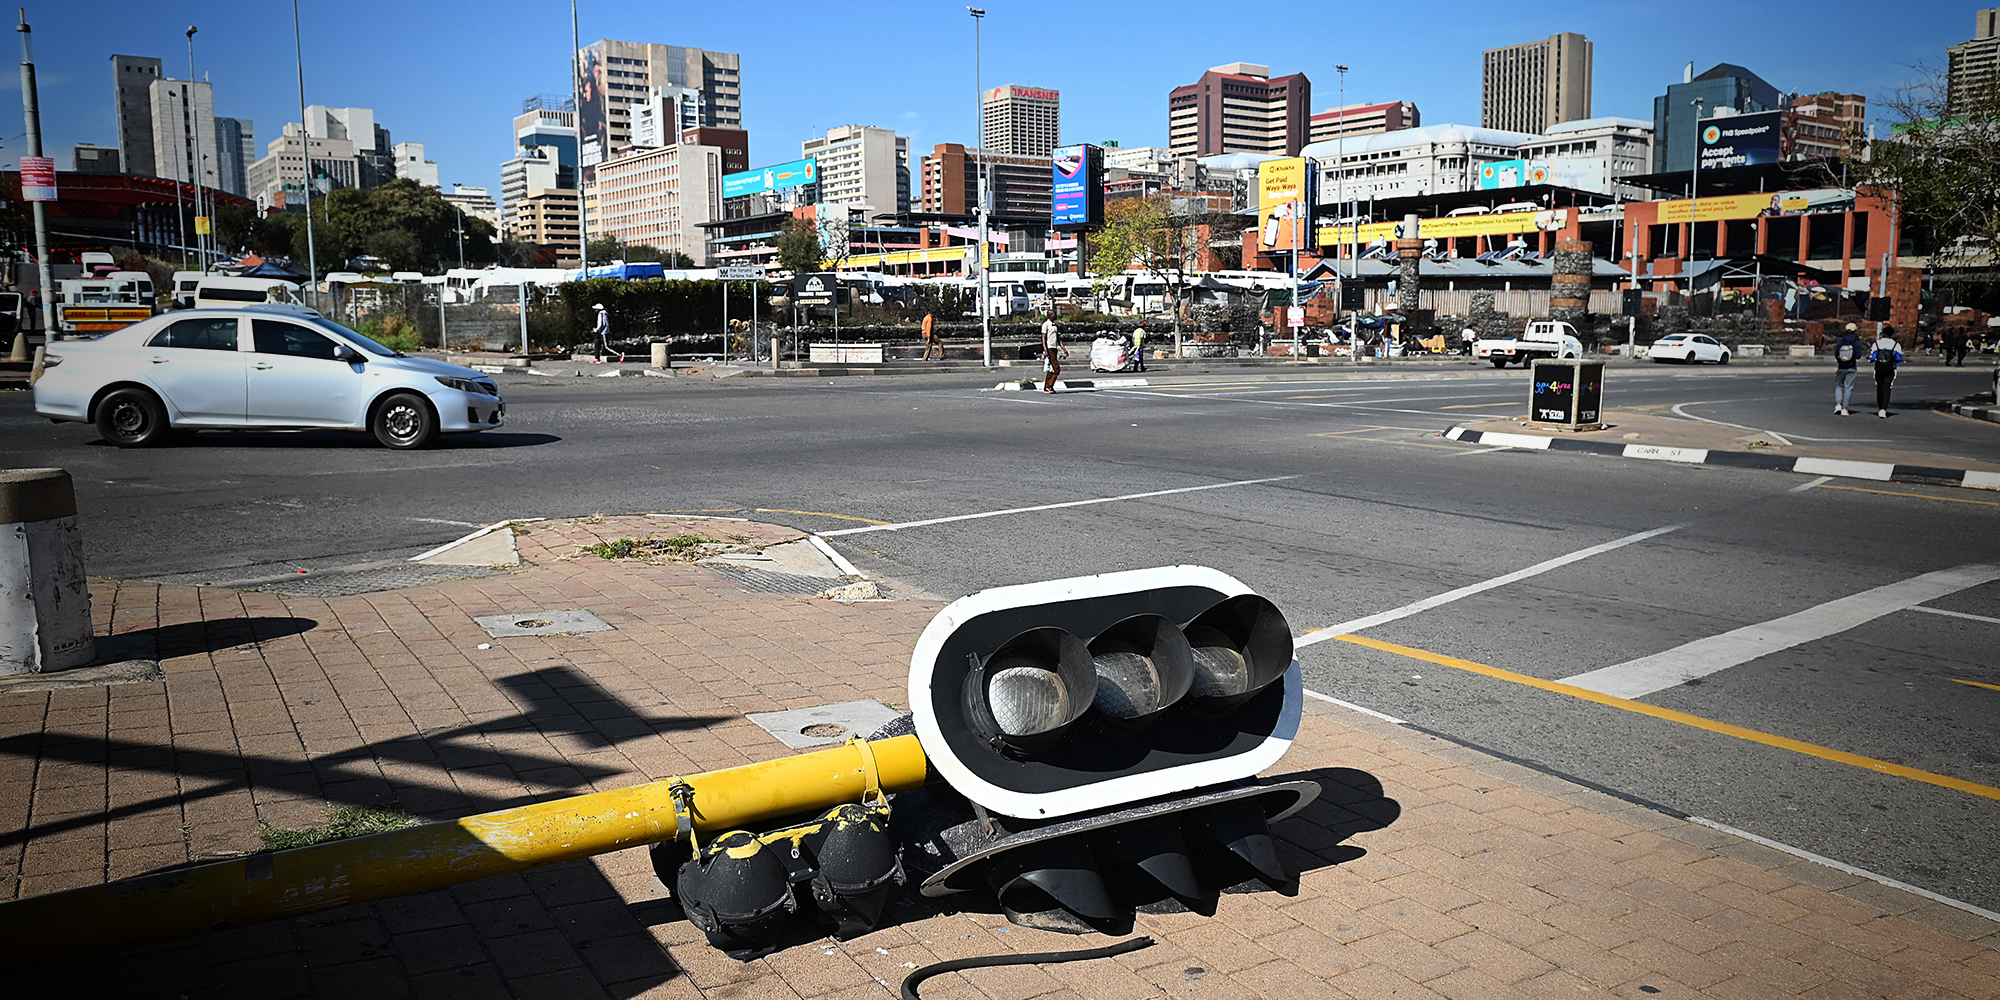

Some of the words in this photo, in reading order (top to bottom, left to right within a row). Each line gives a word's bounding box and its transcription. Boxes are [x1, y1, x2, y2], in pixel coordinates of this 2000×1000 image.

[1012, 88, 1059, 100] TRANSNET
[1722, 129, 1734, 137] FNB
[1702, 146, 1734, 157] Accept
[1266, 183, 1297, 193] Waya-Waya
